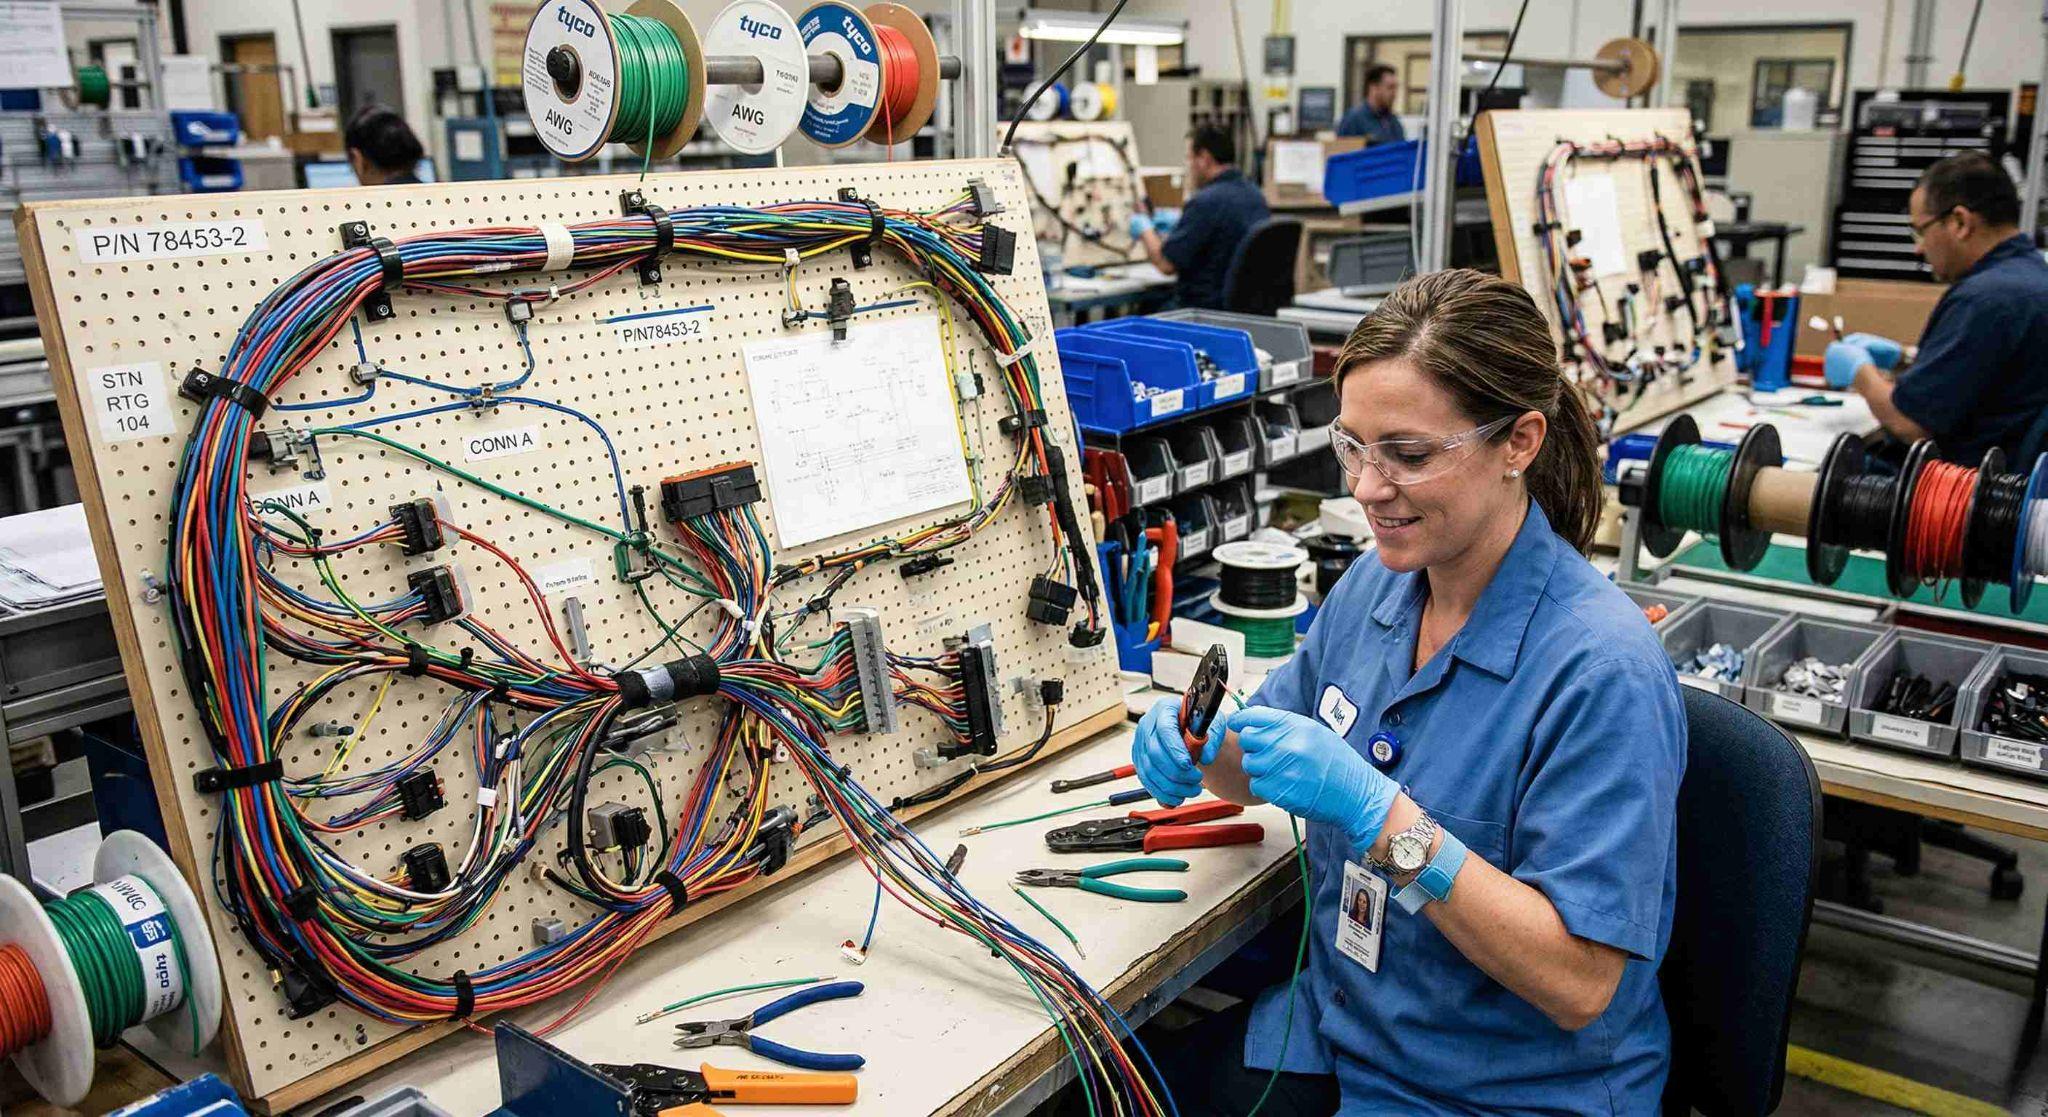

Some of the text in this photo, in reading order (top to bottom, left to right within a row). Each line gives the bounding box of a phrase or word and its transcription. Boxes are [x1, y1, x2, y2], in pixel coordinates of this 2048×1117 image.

[557, 6, 596, 39] tyco
[739, 15, 782, 40] tyco
[842, 15, 872, 56] tyco
[545, 108, 573, 135] AWG
[732, 103, 764, 126] AWG
[93, 226, 248, 256] P/N 78453-2
[623, 320, 701, 343] P/N78453-2
[102, 371, 143, 389] STN
[106, 393, 149, 412] RTG
[116, 415, 149, 432] 104
[470, 432, 534, 455] CONN A
[308, 490, 320, 505] A
[156, 952, 170, 989] tyco
